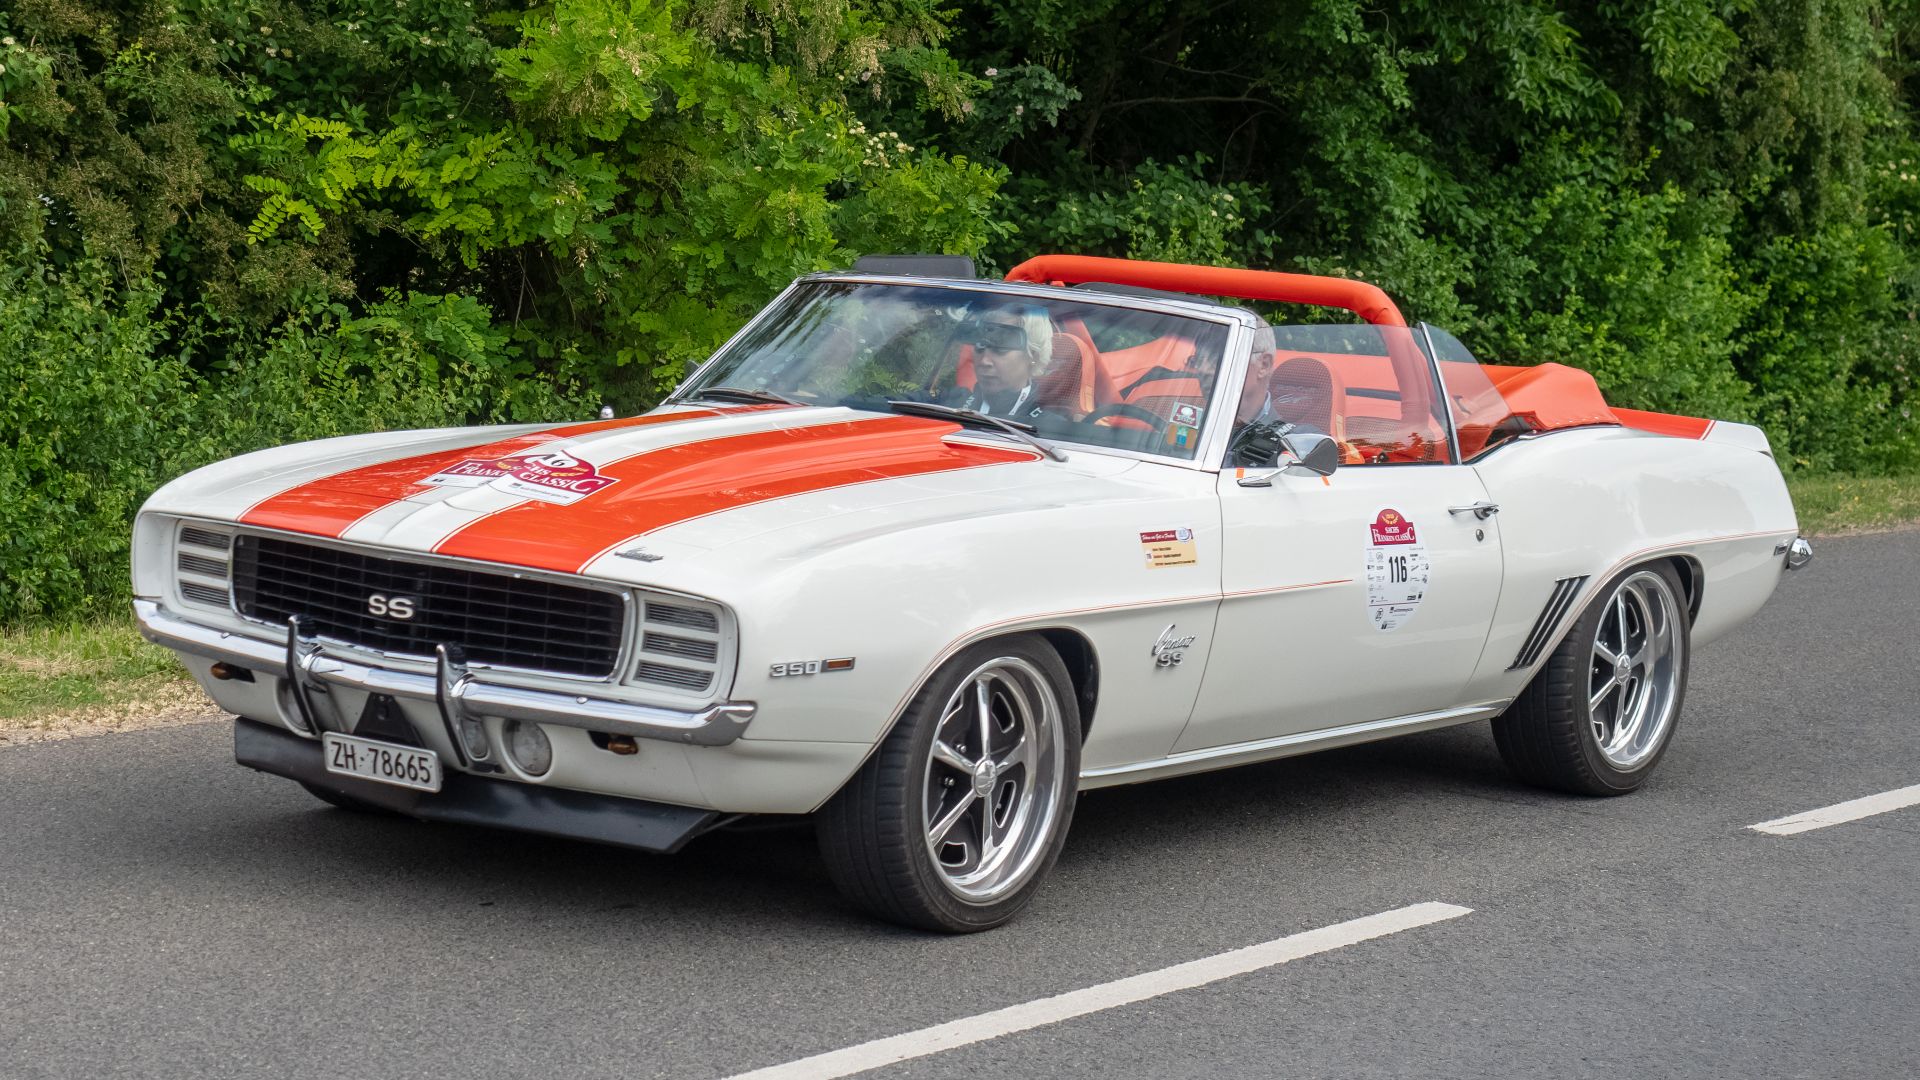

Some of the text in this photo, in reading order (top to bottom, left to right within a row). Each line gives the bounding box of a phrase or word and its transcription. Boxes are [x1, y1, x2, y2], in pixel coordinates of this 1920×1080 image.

[519, 471, 606, 492] CLASSIC
[1388, 555, 1407, 583] 116
[368, 594, 414, 618] SS
[769, 661, 819, 677] 350
[1156, 652, 1184, 667] SS
